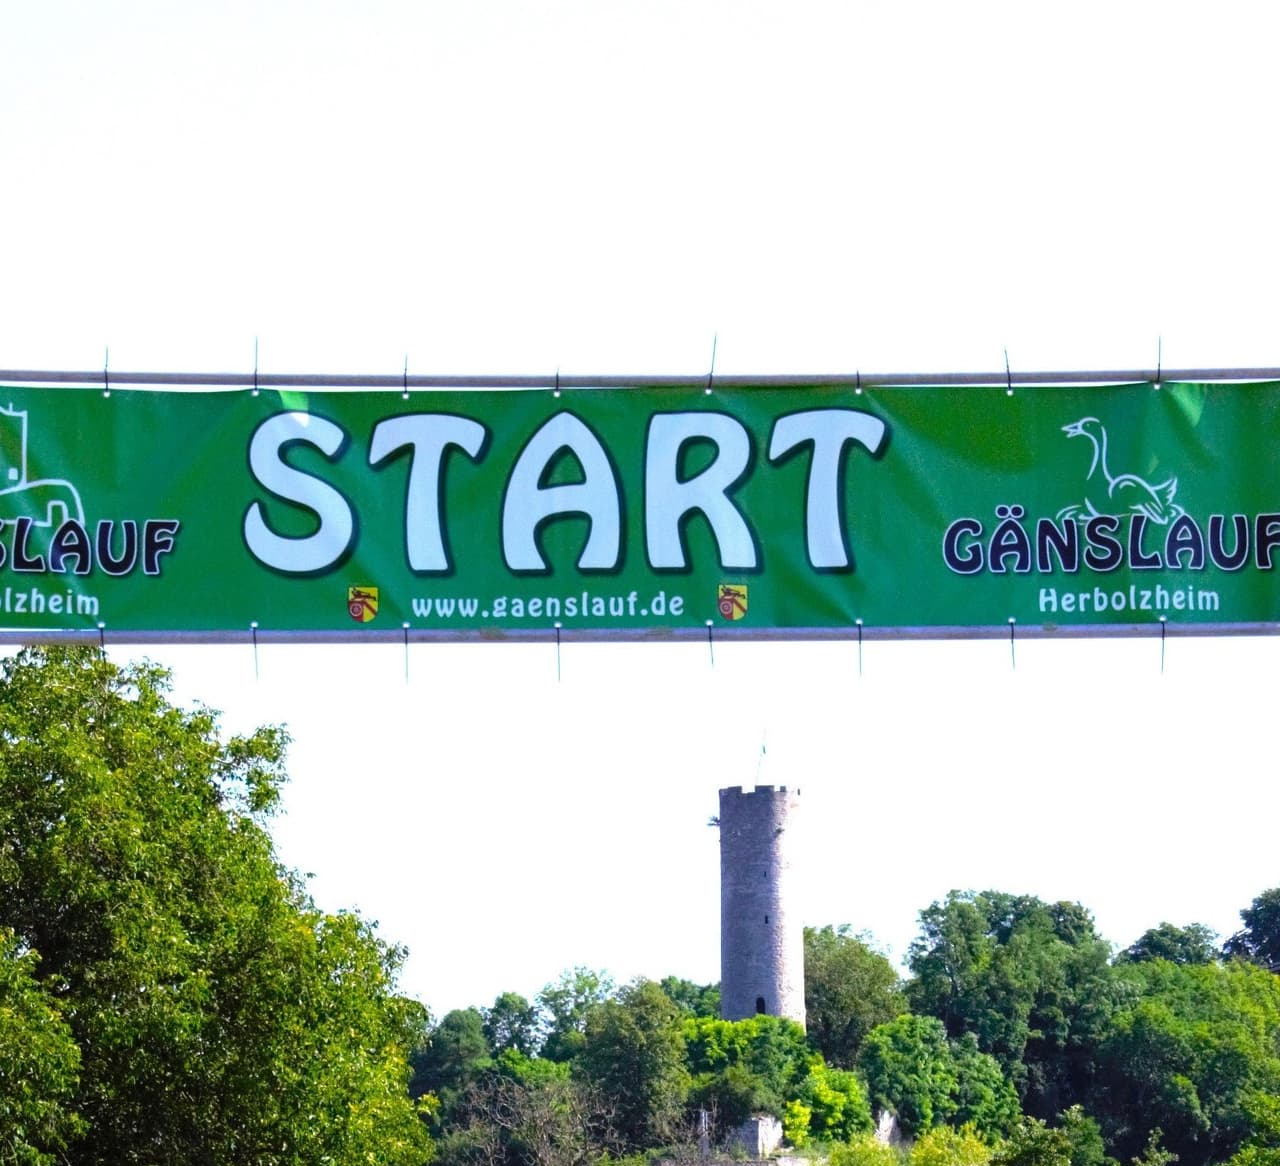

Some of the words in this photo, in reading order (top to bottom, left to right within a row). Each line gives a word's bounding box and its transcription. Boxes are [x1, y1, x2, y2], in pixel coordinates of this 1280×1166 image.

[242, 409, 887, 574] START
[412, 591, 684, 618] www.gaenslauf.de
[1039, 586, 1220, 612] Herbolzheim
